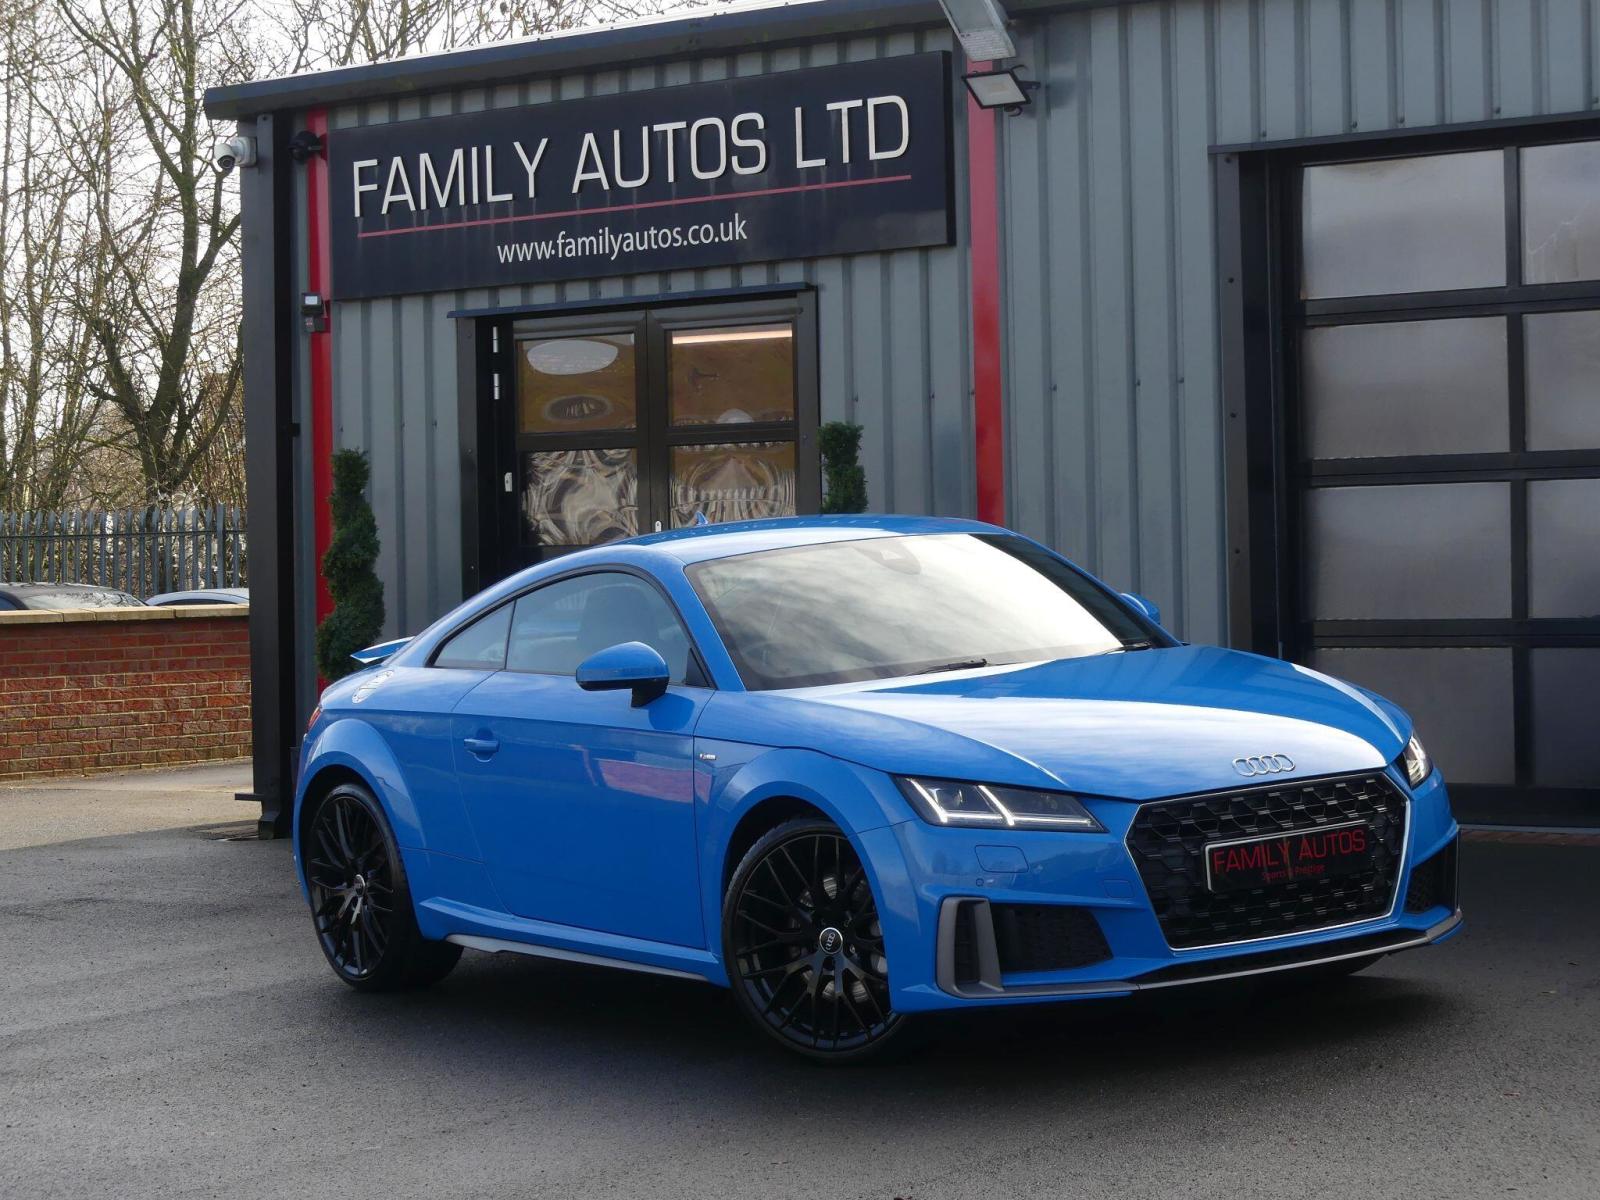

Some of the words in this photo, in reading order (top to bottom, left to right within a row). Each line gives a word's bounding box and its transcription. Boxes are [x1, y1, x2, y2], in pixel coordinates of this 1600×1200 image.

[353, 138, 549, 218] FAMILY
[571, 112, 768, 195] AUTOS
[794, 95, 910, 170] LTD
[497, 212, 748, 264] www.familyautos.co.uk
[1212, 840, 1291, 874] FAMILY
[1298, 829, 1366, 860] AUTOS
